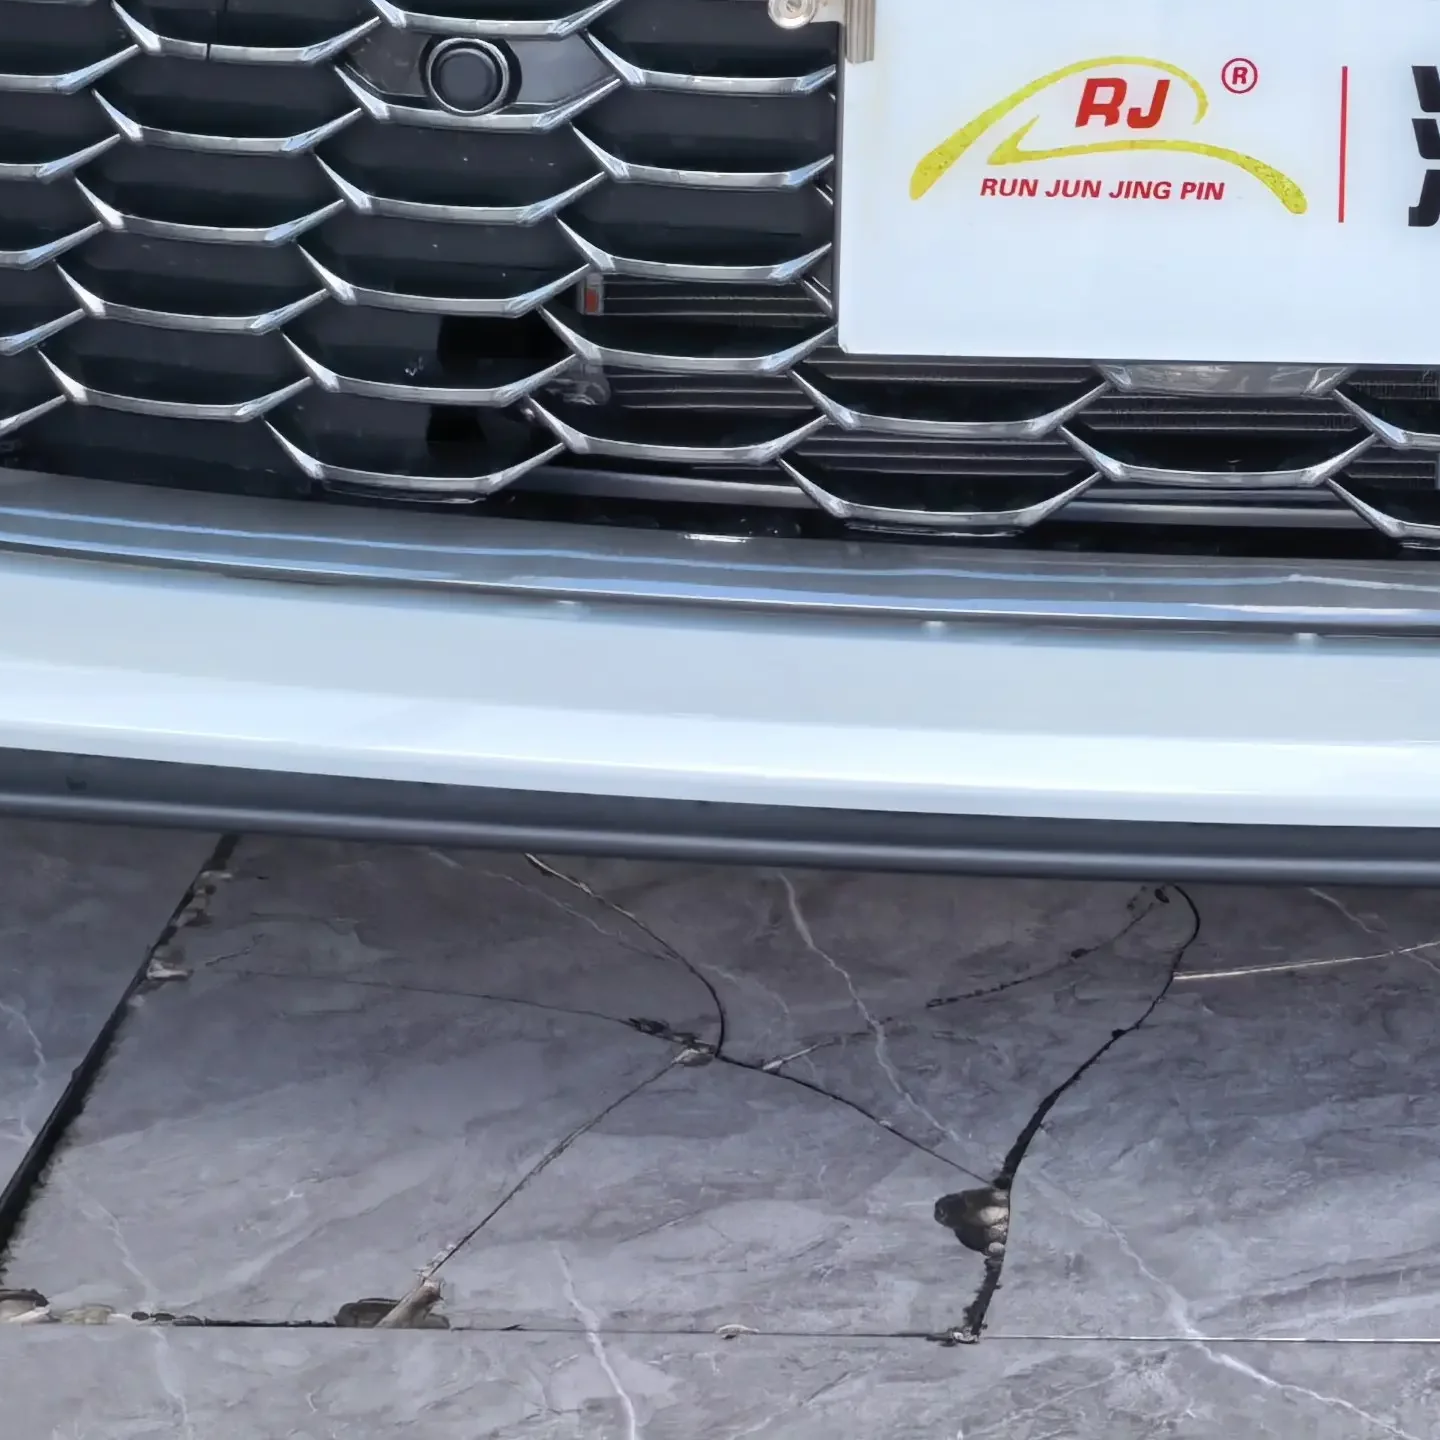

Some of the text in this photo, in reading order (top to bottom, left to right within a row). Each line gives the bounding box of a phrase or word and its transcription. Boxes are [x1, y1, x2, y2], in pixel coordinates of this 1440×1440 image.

[1074, 77, 1171, 129] RJ
[979, 177, 1225, 201] RUN JUN JING PIN
